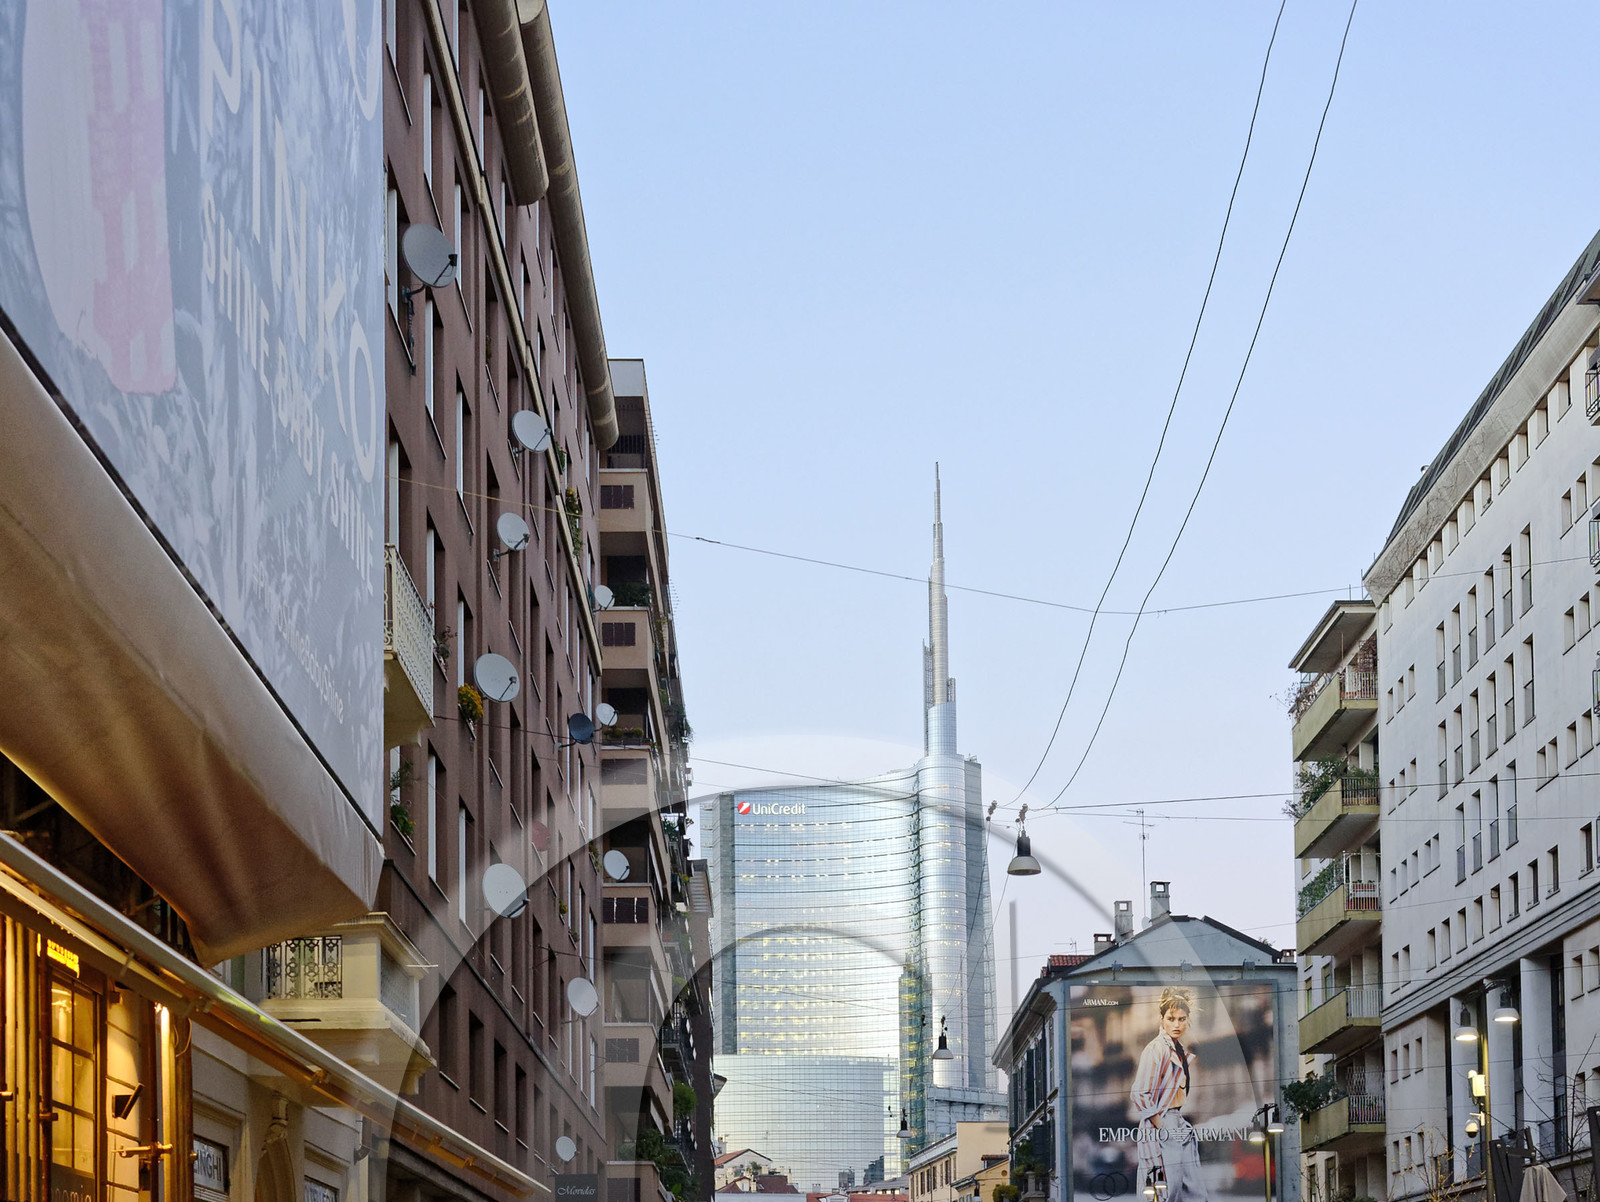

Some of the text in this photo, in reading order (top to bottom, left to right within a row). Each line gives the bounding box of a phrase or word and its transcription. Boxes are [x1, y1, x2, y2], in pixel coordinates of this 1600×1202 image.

[202, 183, 375, 597] SHINE BABY SHINE
[752, 803, 806, 815] UniCredit
[1099, 1127, 1249, 1143] EMPORIO ARMANI
